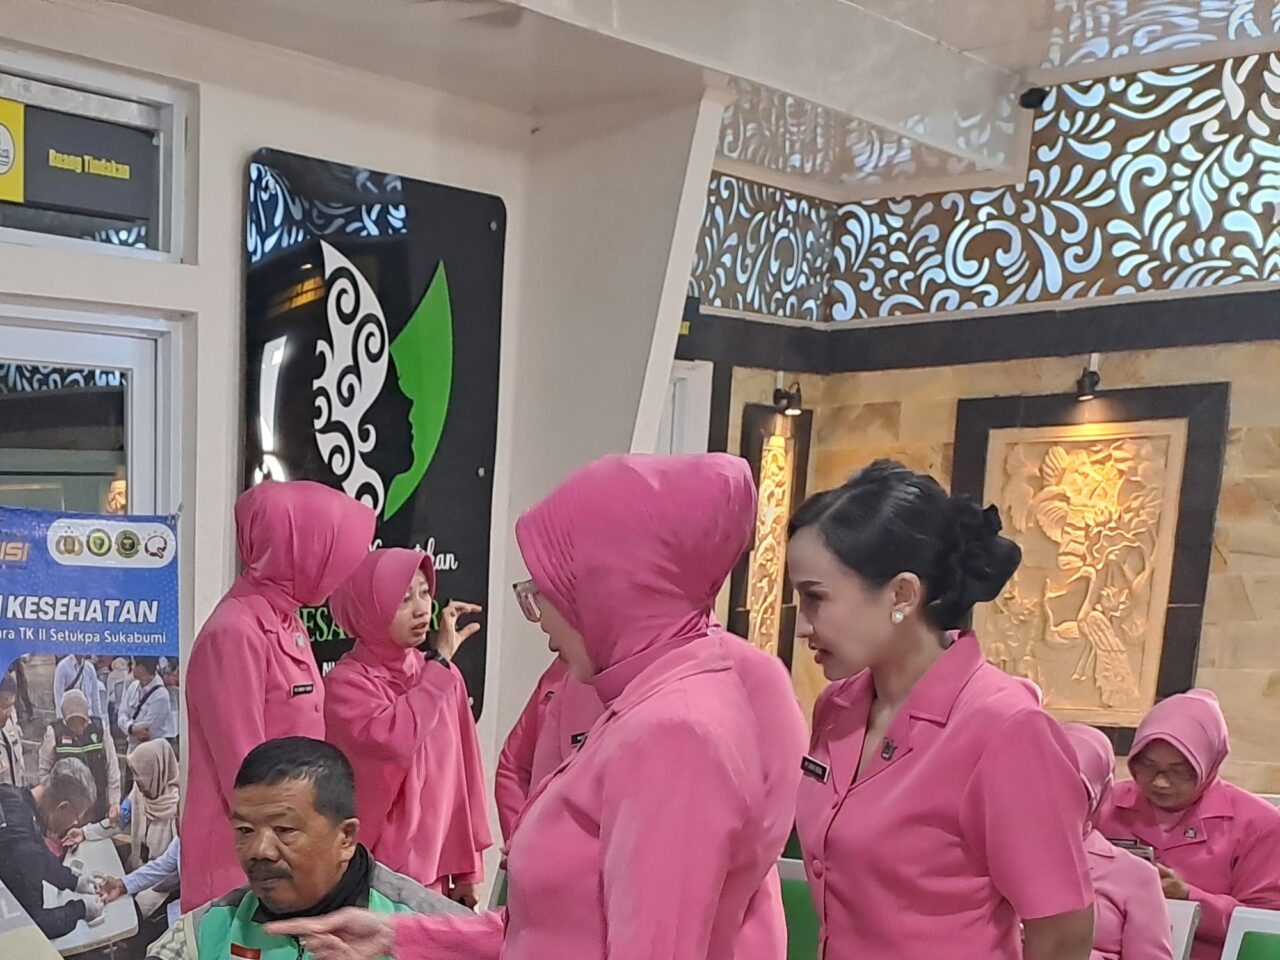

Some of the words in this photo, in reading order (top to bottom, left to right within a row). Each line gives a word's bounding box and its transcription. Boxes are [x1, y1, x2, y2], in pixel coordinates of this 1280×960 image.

[49, 149, 83, 174] Ruang
[83, 155, 130, 179] Tindakan
[6, 594, 158, 624] KESEHATAN
[19, 627, 35, 641] TK
[50, 629, 100, 645] Setukpa
[104, 630, 167, 645] Sukabumi
